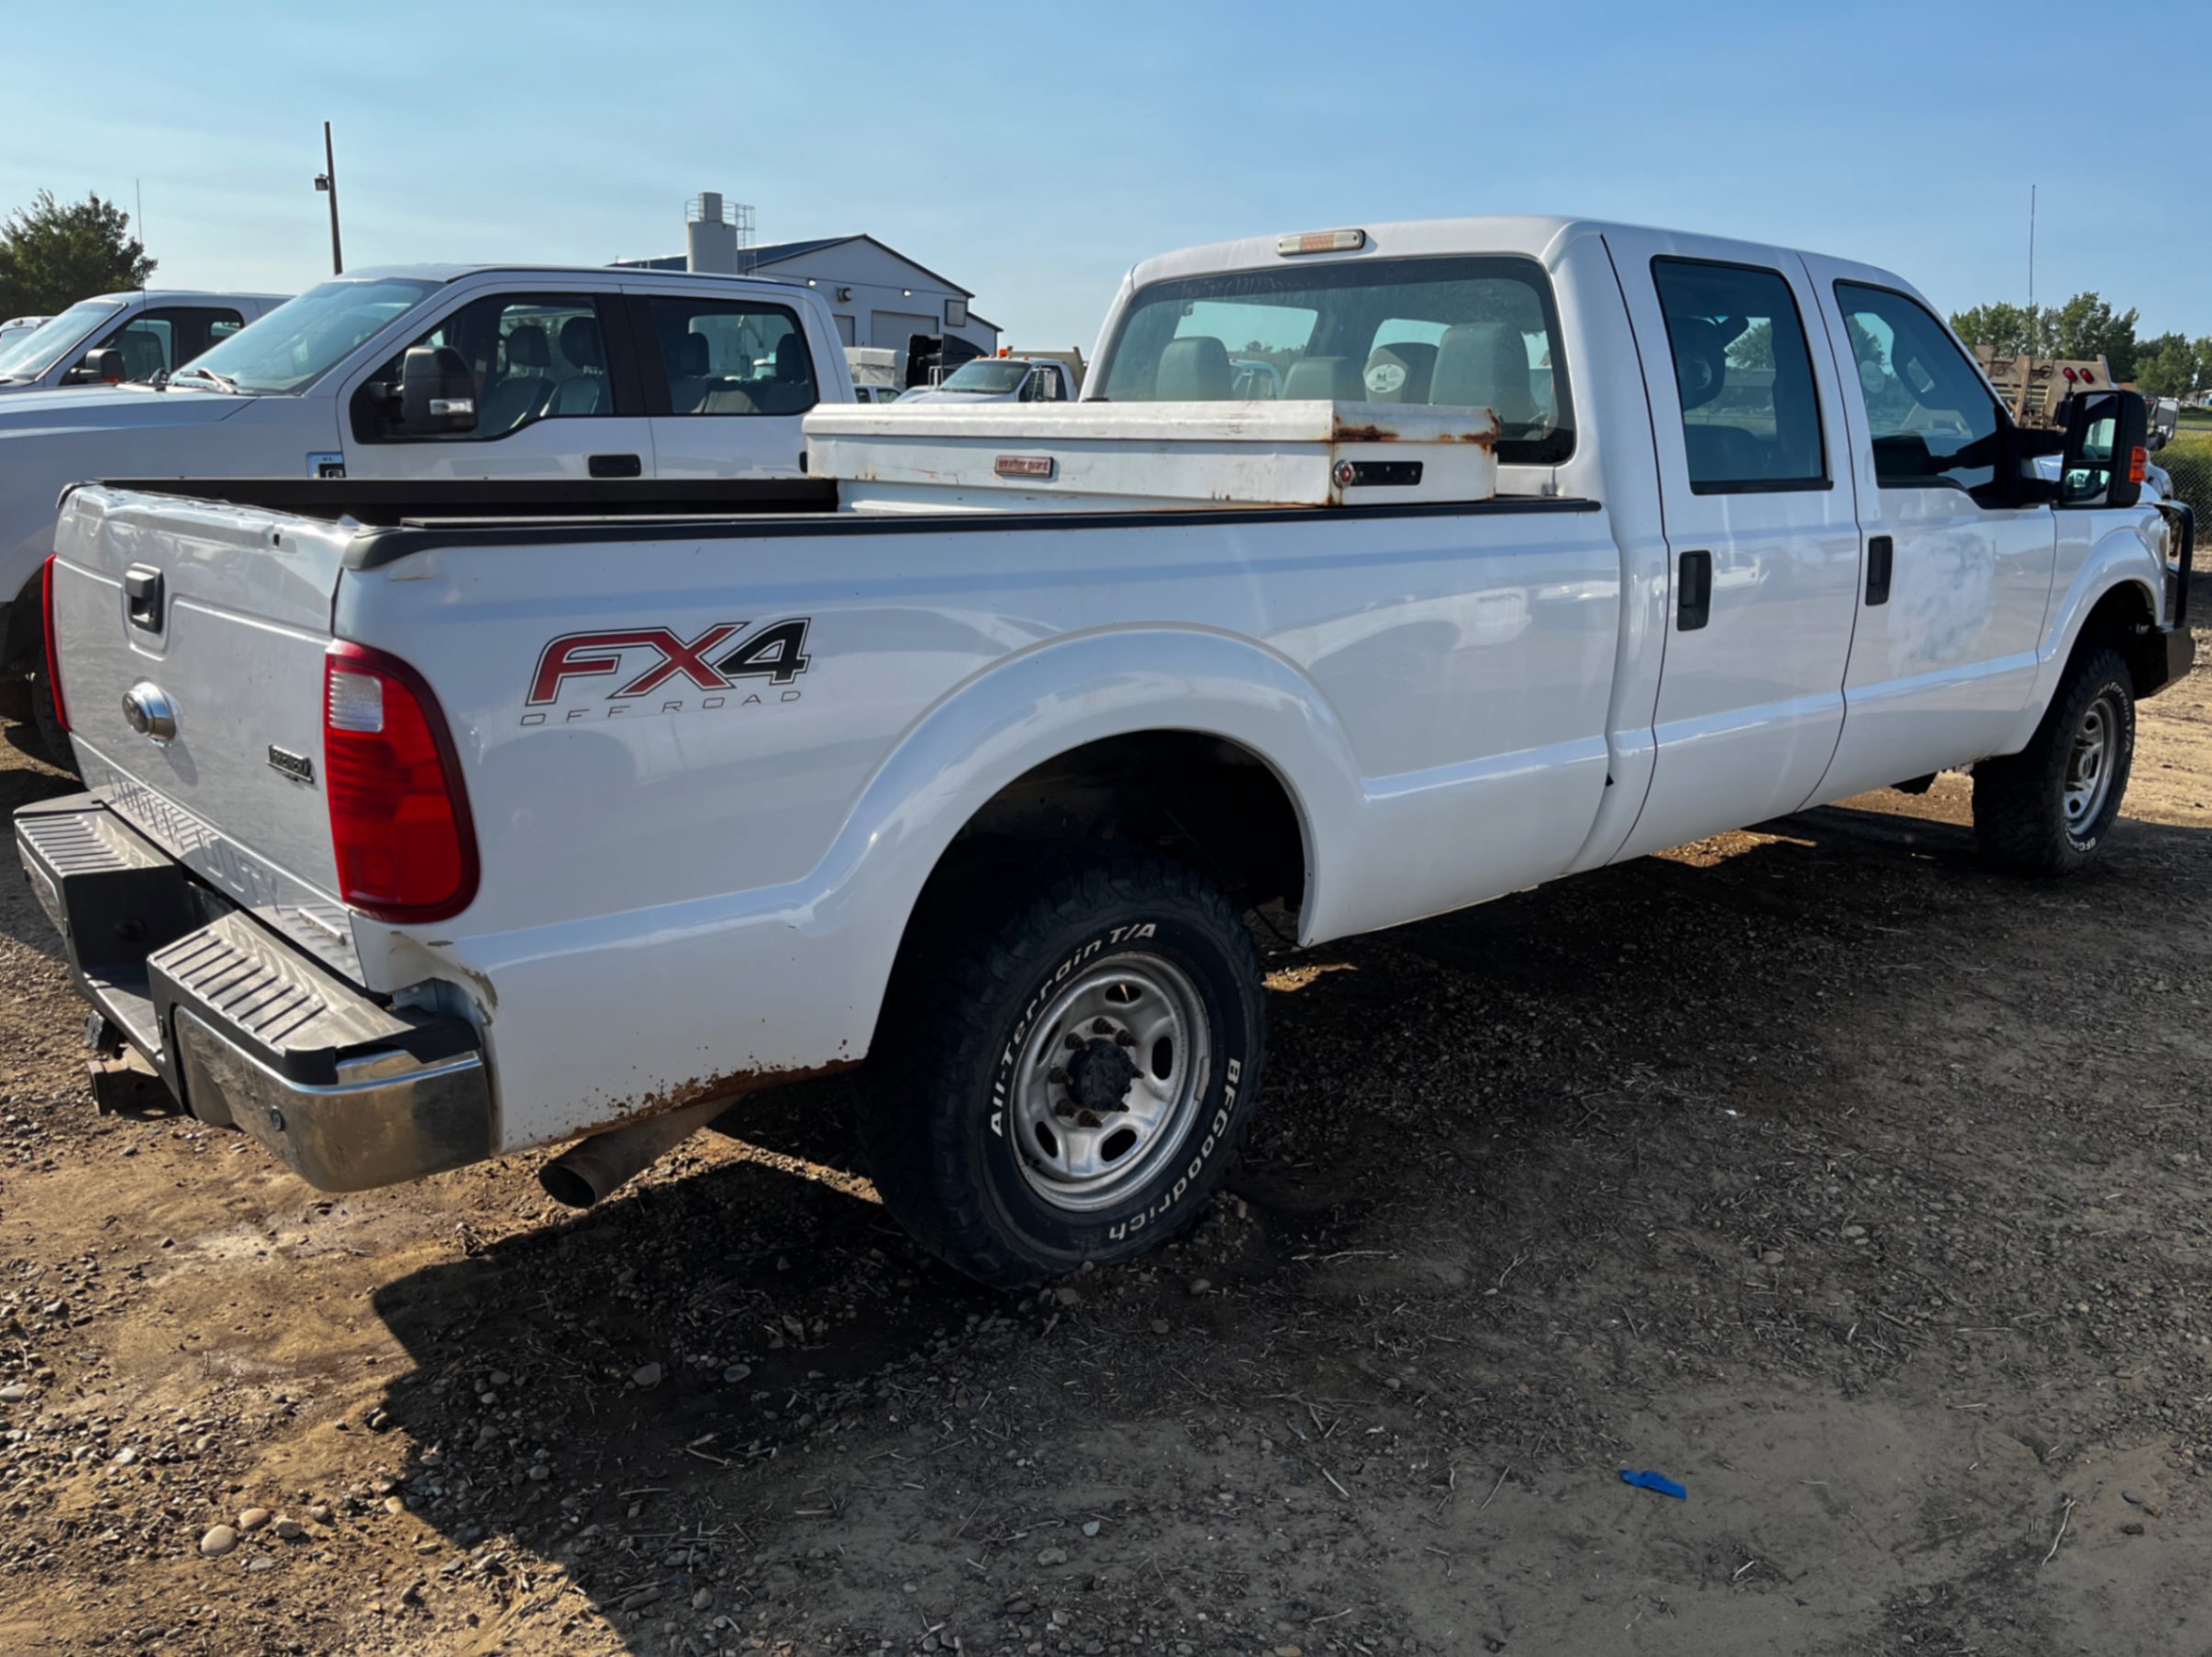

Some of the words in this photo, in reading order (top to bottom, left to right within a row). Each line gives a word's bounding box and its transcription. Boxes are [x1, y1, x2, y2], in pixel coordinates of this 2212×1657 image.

[525, 617, 812, 706] FX4
[520, 705, 631, 727] OFF
[661, 690, 802, 714] ROAD
[1109, 922, 1157, 944] T/A
[1107, 1057, 1242, 1241] BFGoodrich
